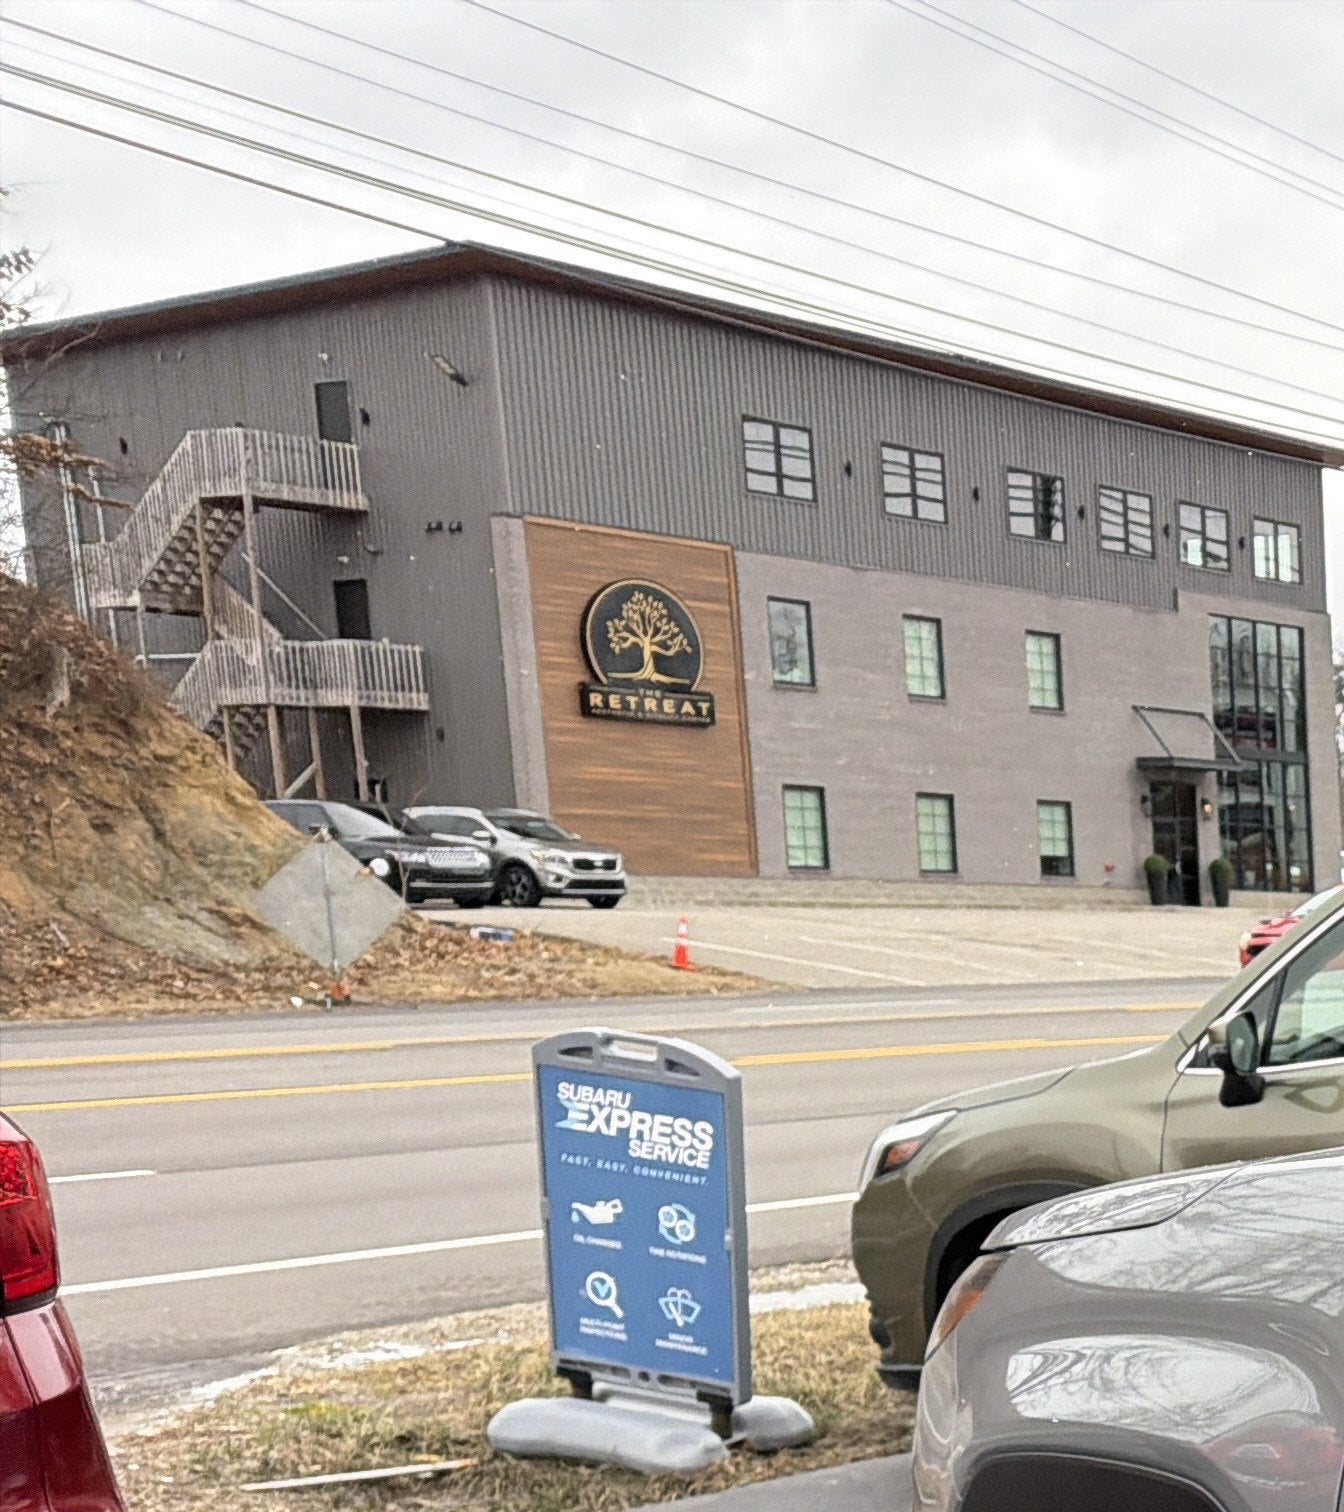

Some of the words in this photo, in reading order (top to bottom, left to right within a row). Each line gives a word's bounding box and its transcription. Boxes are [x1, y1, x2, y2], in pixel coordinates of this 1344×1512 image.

[589, 692, 711, 716] RETREAT
[557, 1081, 632, 1109] SUBARU
[556, 1101, 714, 1151] EXPRESS
[628, 1139, 711, 1170] SERVICE
